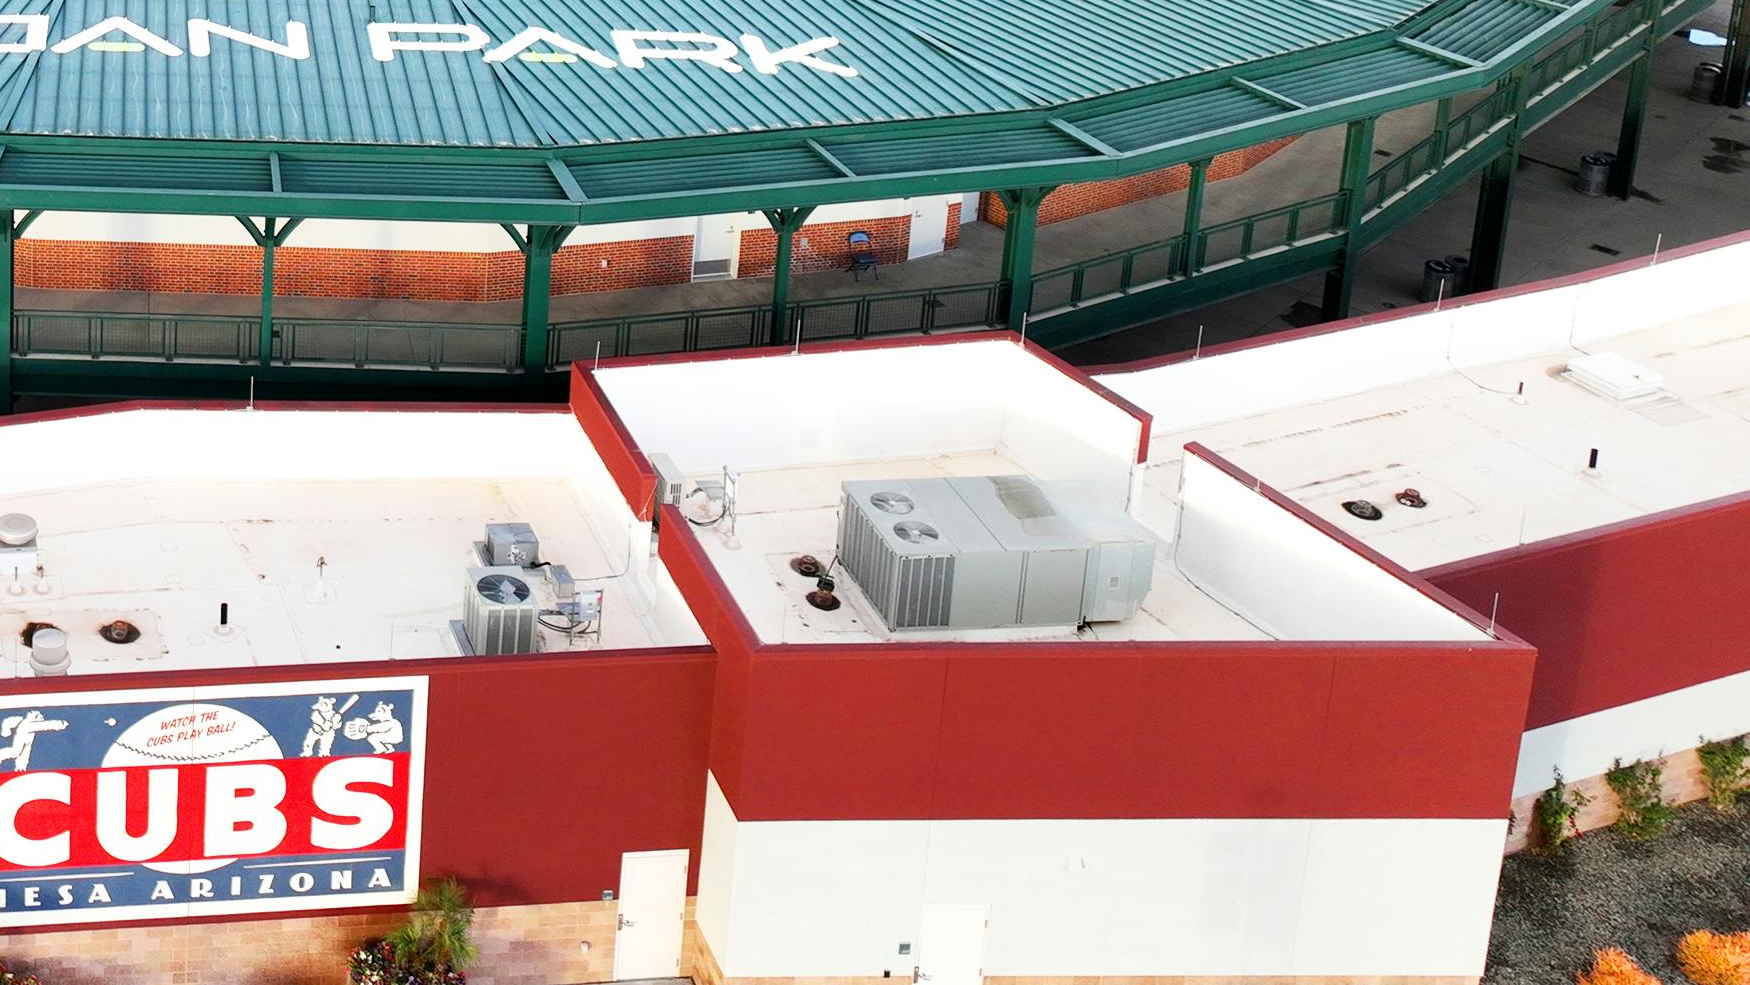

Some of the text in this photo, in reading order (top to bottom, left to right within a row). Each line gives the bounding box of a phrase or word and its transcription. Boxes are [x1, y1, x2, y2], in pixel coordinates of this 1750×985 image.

[367, 21, 859, 78] PARK
[146, 721, 236, 748] CUBS PLAY BALL!
[160, 710, 220, 731] WATCH THE
[150, 867, 393, 901] ARIZONA
